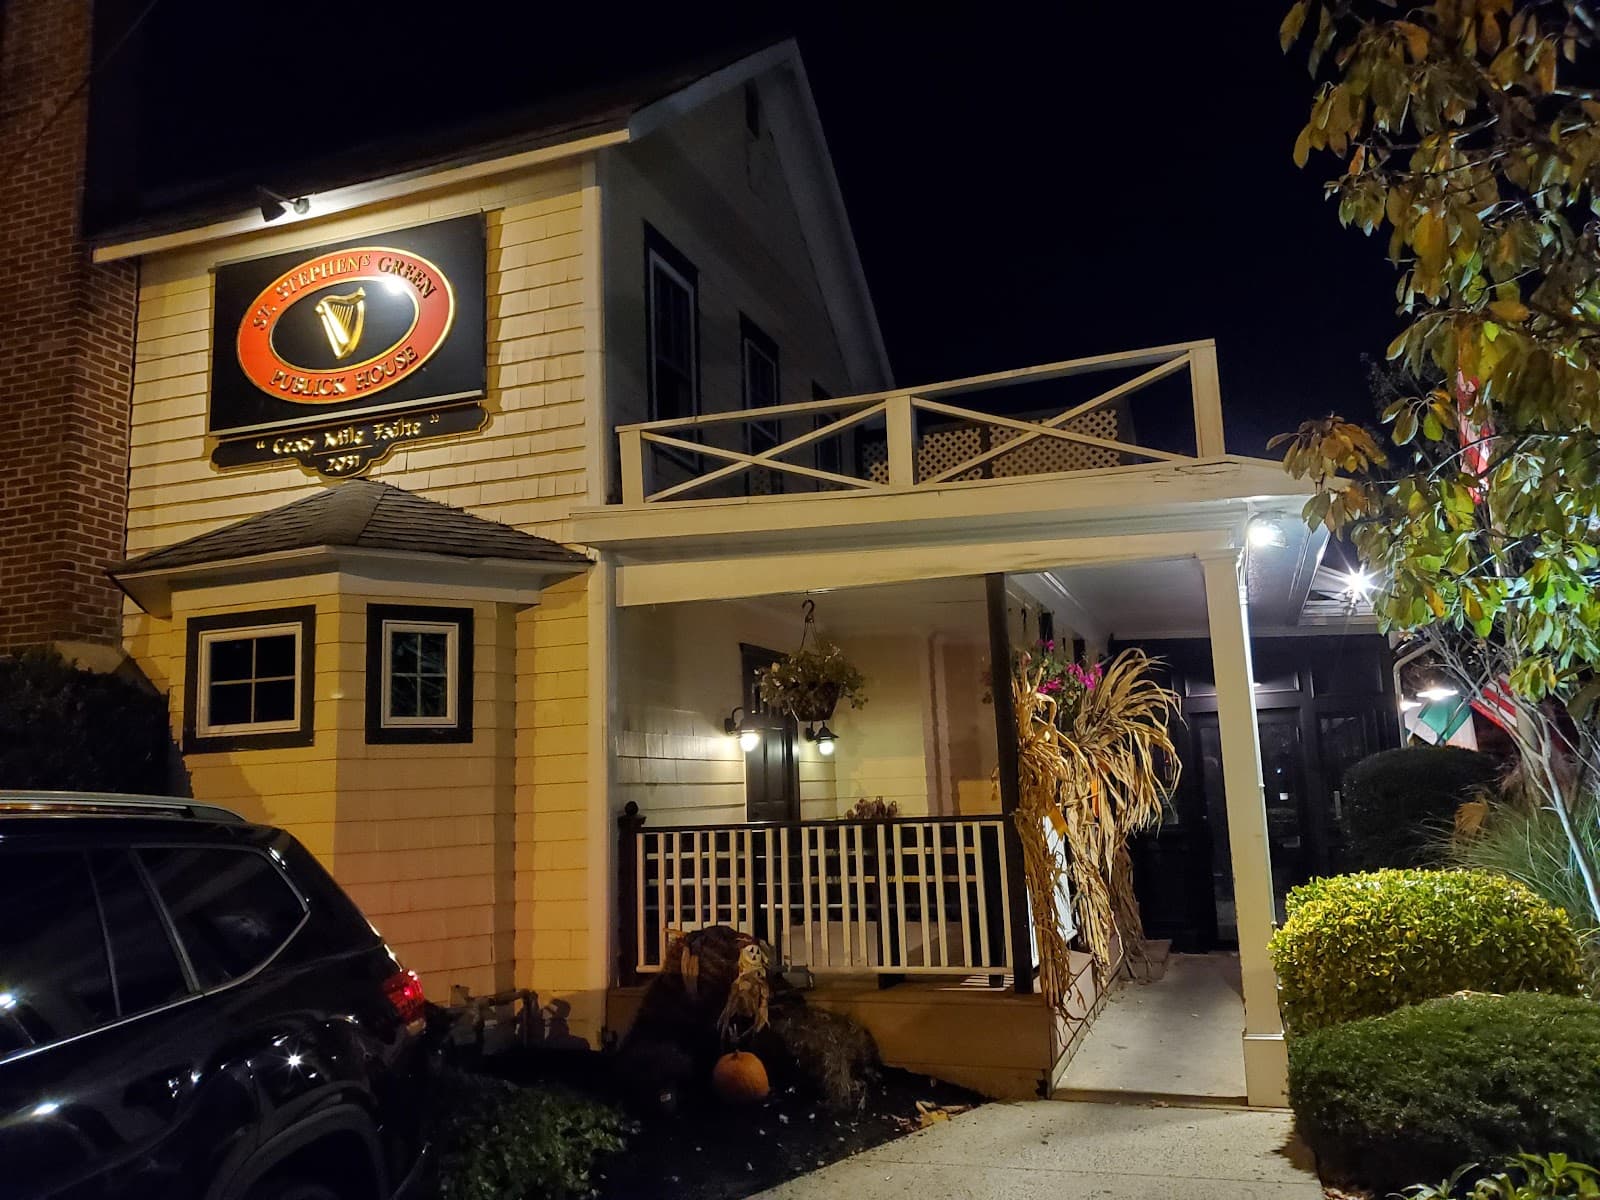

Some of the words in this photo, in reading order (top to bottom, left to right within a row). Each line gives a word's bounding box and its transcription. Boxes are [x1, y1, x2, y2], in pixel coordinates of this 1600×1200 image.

[253, 303, 277, 331] ST.
[377, 256, 437, 298] GREEN
[269, 369, 348, 396] PUBLICK
[354, 346, 419, 390] HOUSE
